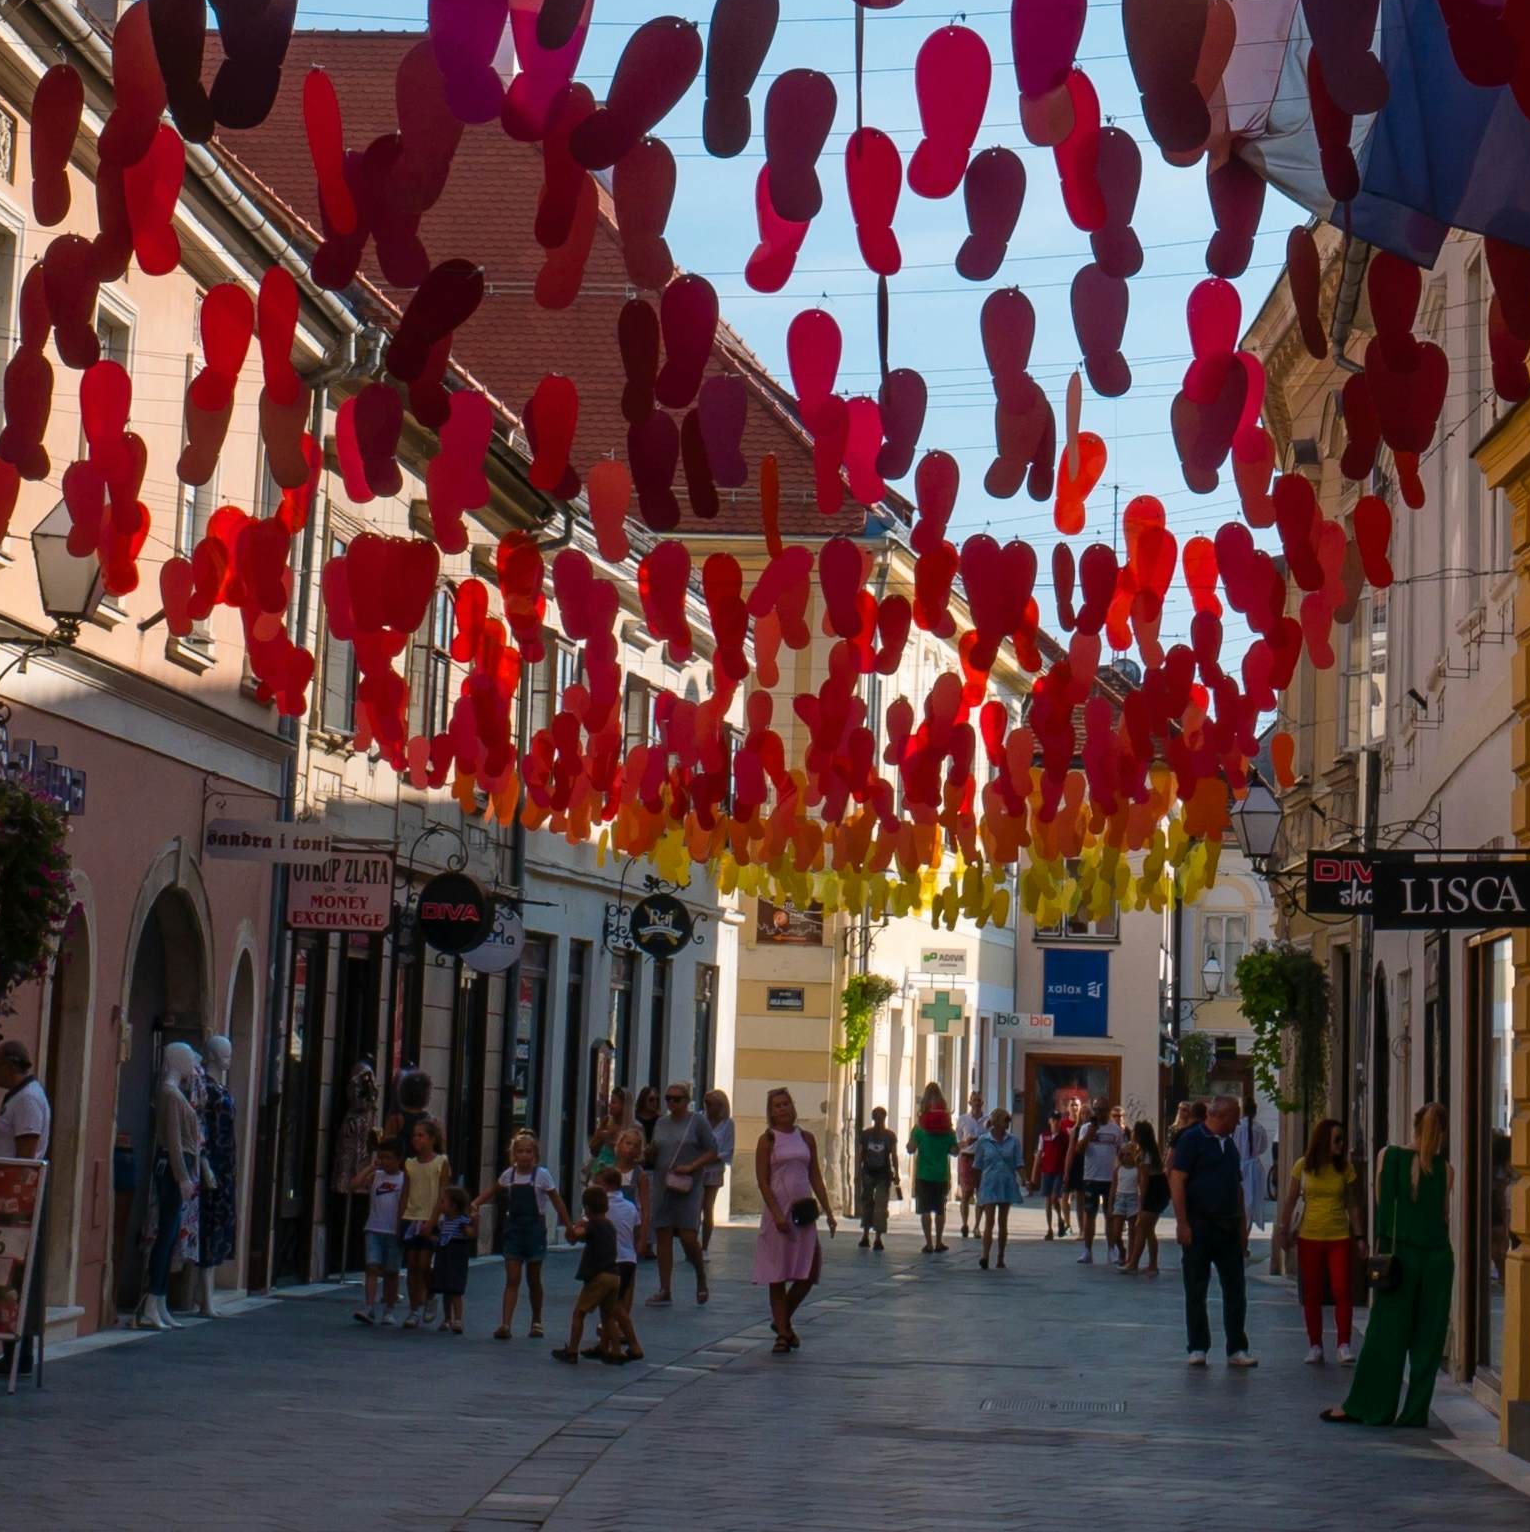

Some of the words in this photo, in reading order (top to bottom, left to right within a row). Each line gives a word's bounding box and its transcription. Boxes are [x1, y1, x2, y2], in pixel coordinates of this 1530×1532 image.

[280, 833, 286, 849] i
[293, 836, 331, 852] toni
[345, 859, 389, 885] ZLATA
[1313, 858, 1373, 883] DIV
[310, 895, 369, 909] MONEY
[1339, 879, 1373, 906] sho
[1400, 875, 1526, 914] LISCA
[292, 911, 384, 927] EXCHANGE
[421, 902, 480, 922] DIVA
[485, 922, 515, 945] erla
